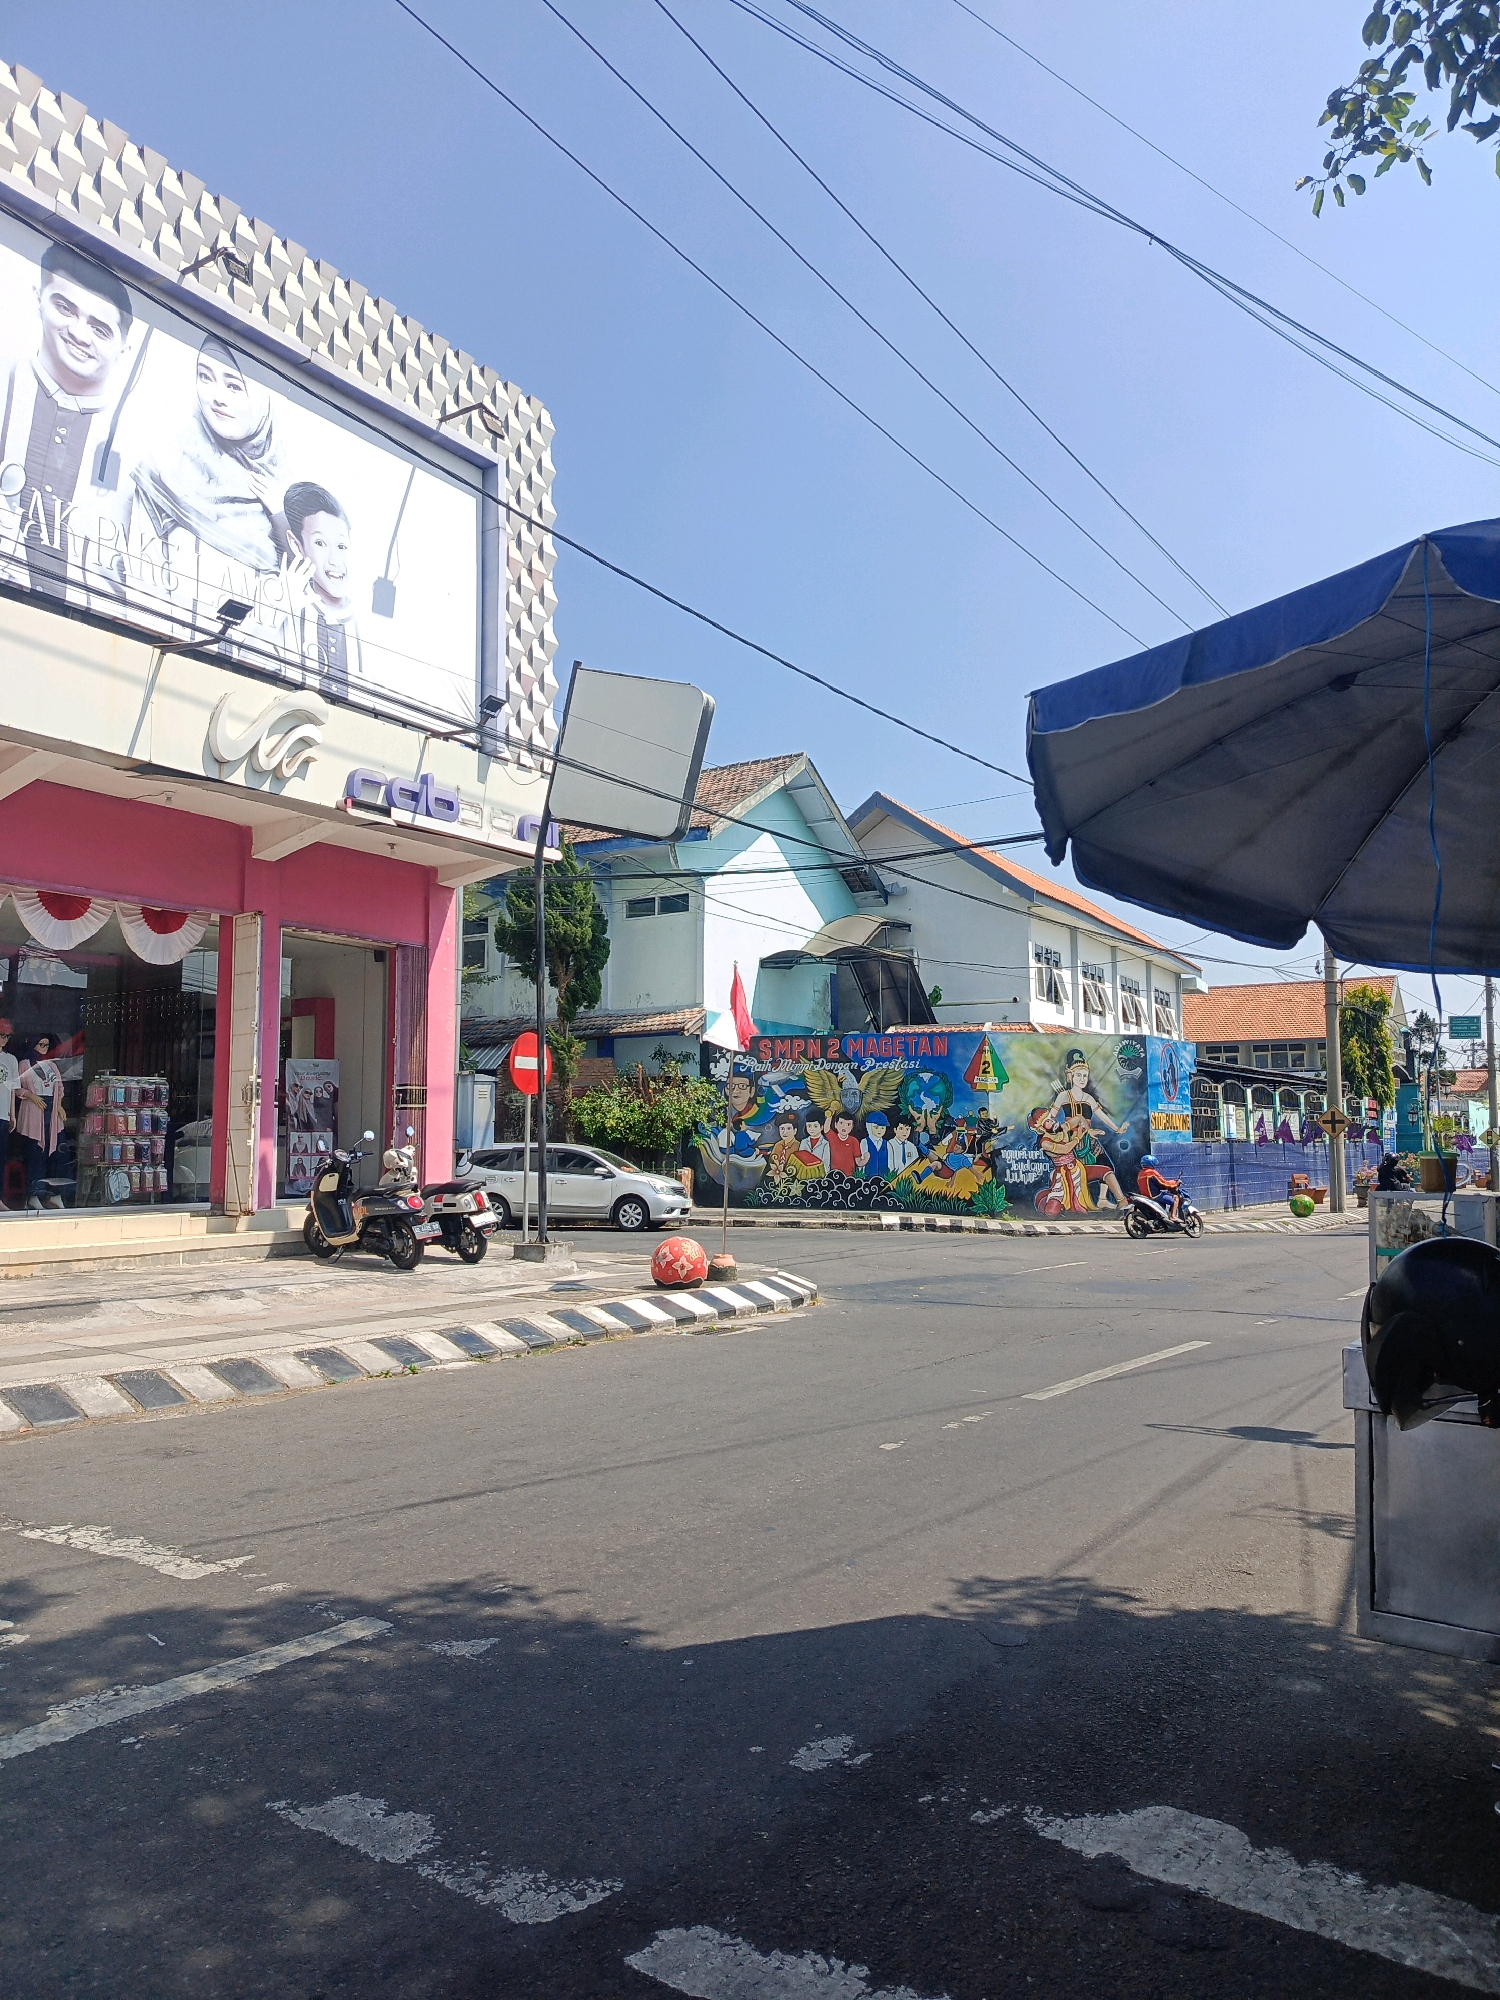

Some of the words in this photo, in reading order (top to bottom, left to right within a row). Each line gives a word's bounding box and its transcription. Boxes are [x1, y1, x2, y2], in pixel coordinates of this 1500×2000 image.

[758, 1038, 821, 1060] SMPN
[827, 1038, 840, 1059] 2
[847, 1036, 948, 1058] MAGETAN
[1112, 1039, 1146, 1058] ADIWIYATA
[741, 1055, 772, 1073] Raih
[772, 1058, 814, 1073] Mimpi
[814, 1058, 858, 1073] Dengan
[860, 1056, 920, 1072] Prestasi
[981, 1060, 991, 1075] 2
[1150, 1111, 1166, 1130] STOP
[1166, 1112, 1191, 1131] BULLYING
